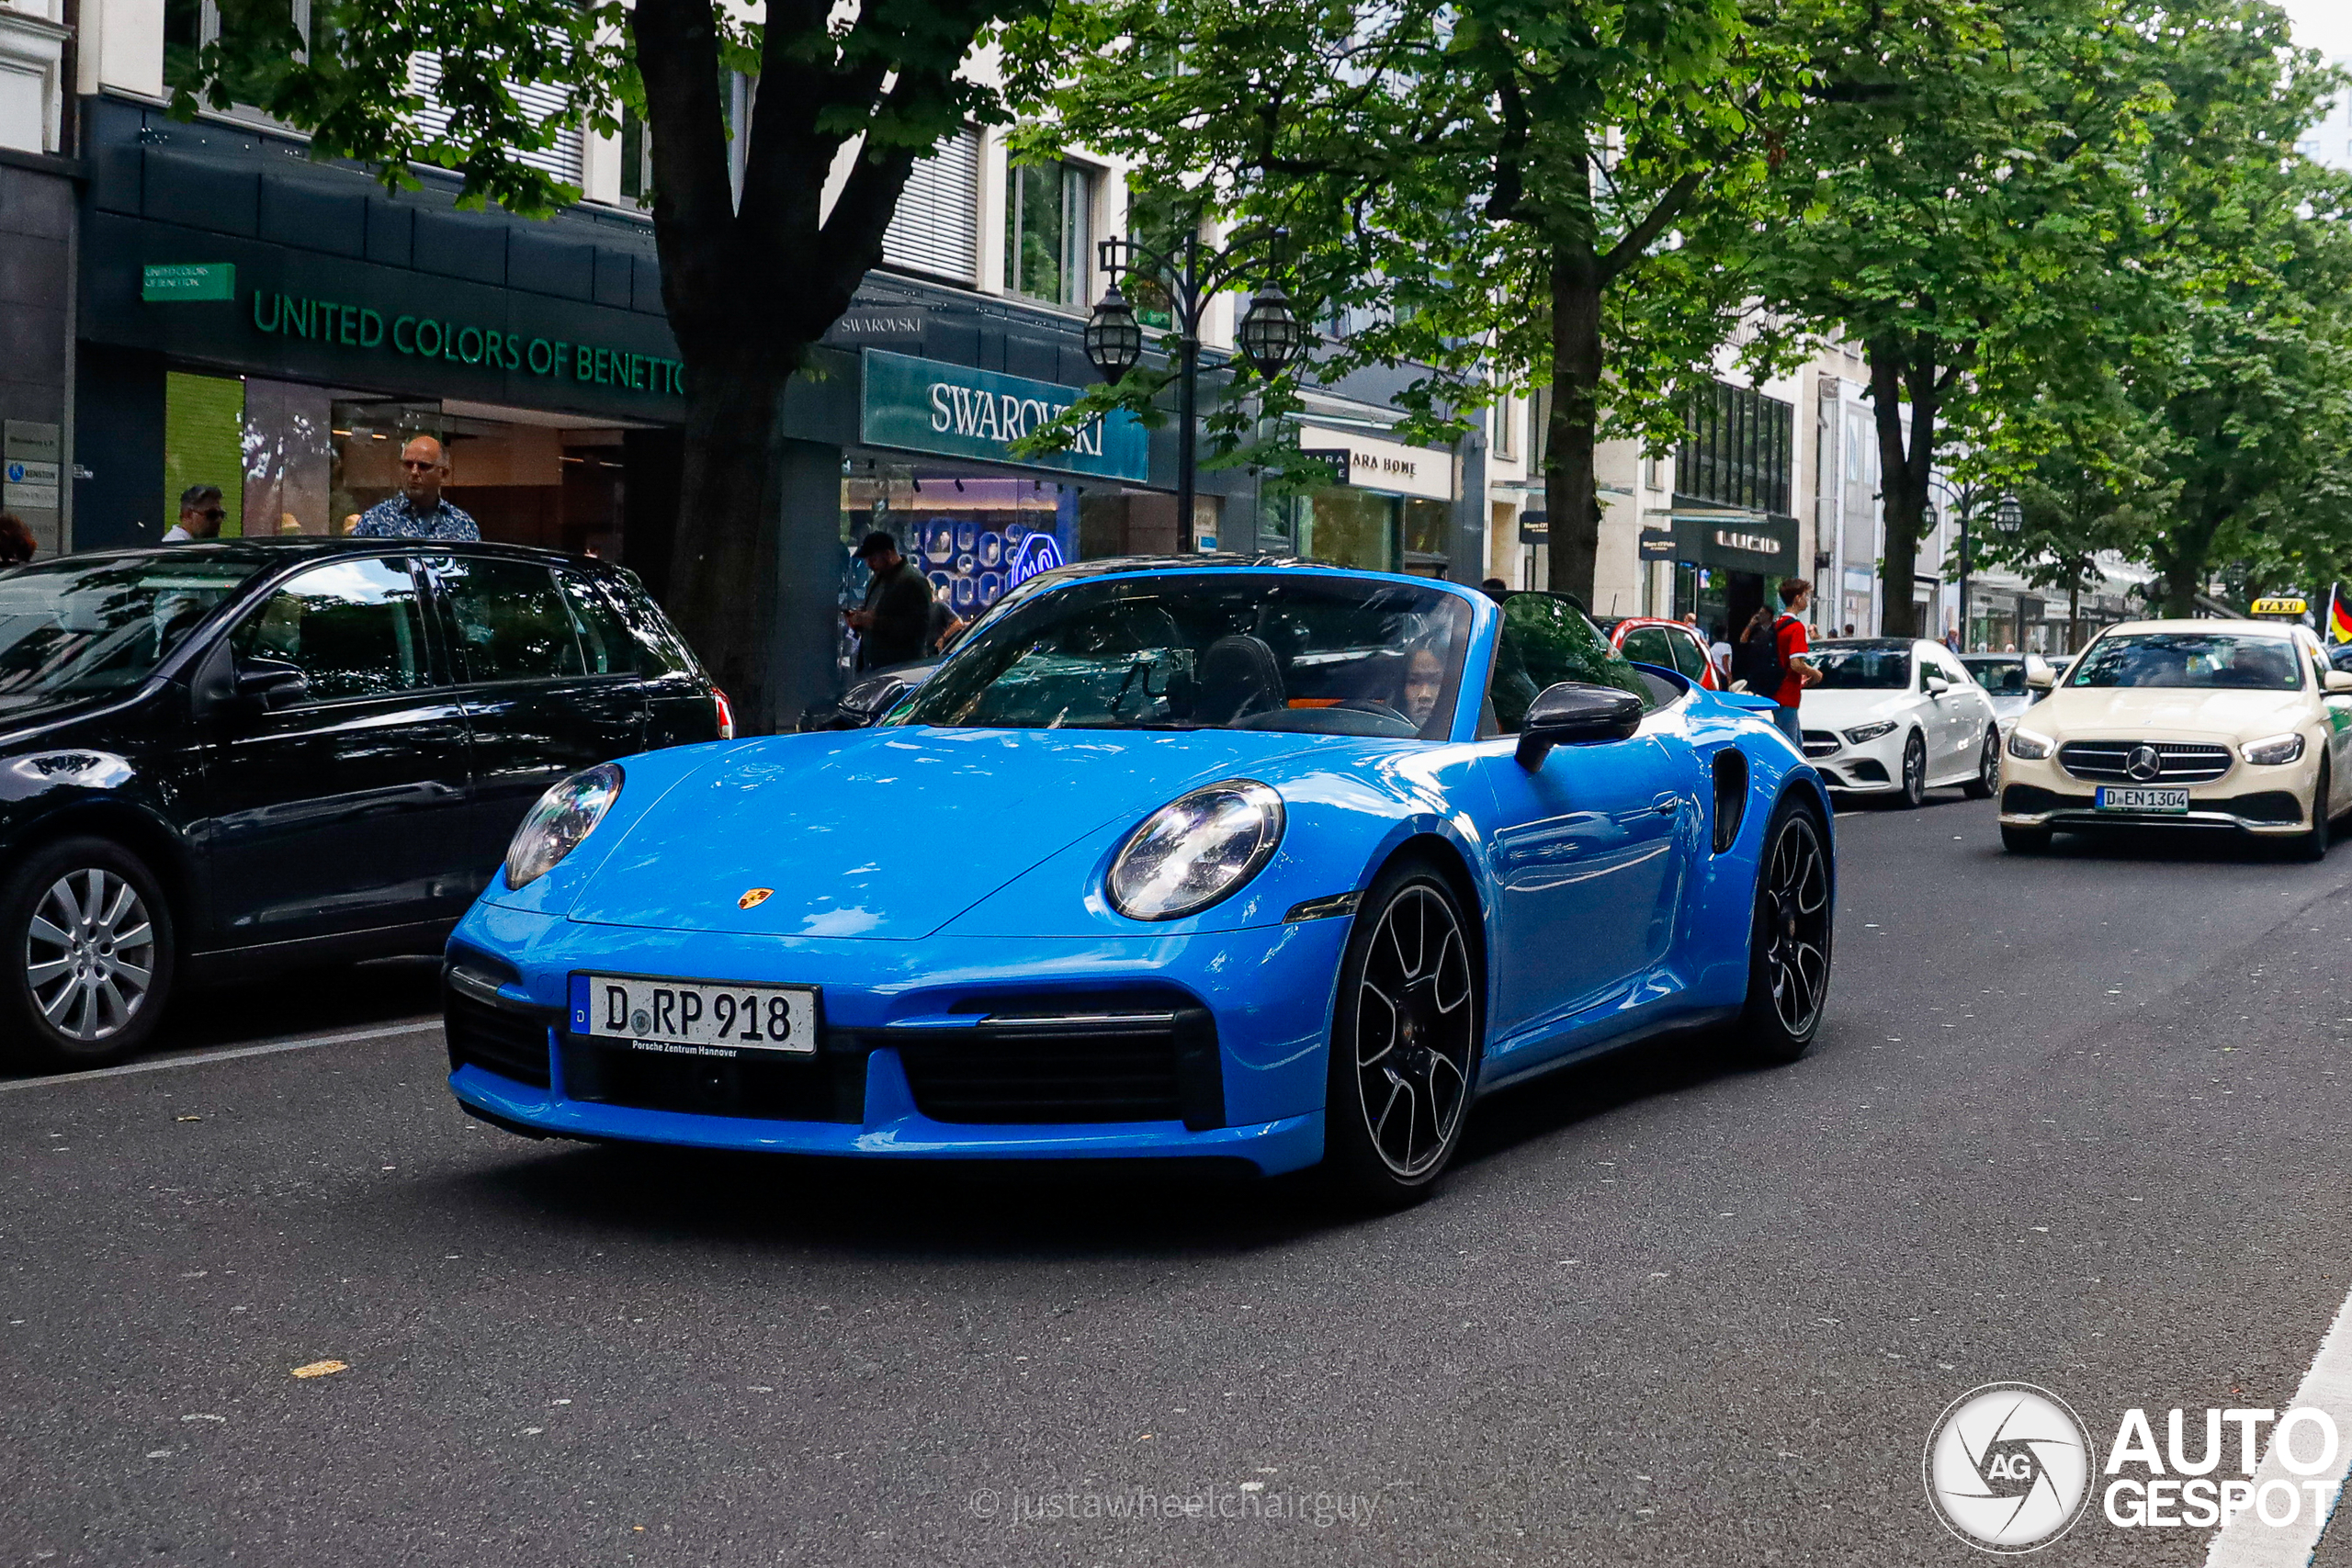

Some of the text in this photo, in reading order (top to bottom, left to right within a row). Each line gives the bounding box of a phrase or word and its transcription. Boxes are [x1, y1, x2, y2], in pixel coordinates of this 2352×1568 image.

[254, 289, 384, 348] UNITED
[393, 314, 520, 370] COLORS
[527, 337, 568, 377] OF
[842, 318, 921, 332] SWAROVSKI
[1352, 452, 1417, 476] ARA HOME
[2259, 601, 2298, 612] TAXI
[2106, 790, 2186, 807] D EN 1304
[605, 985, 791, 1042] D RP 918
[632, 1040, 738, 1057] Porsche Zentrum Hannover
